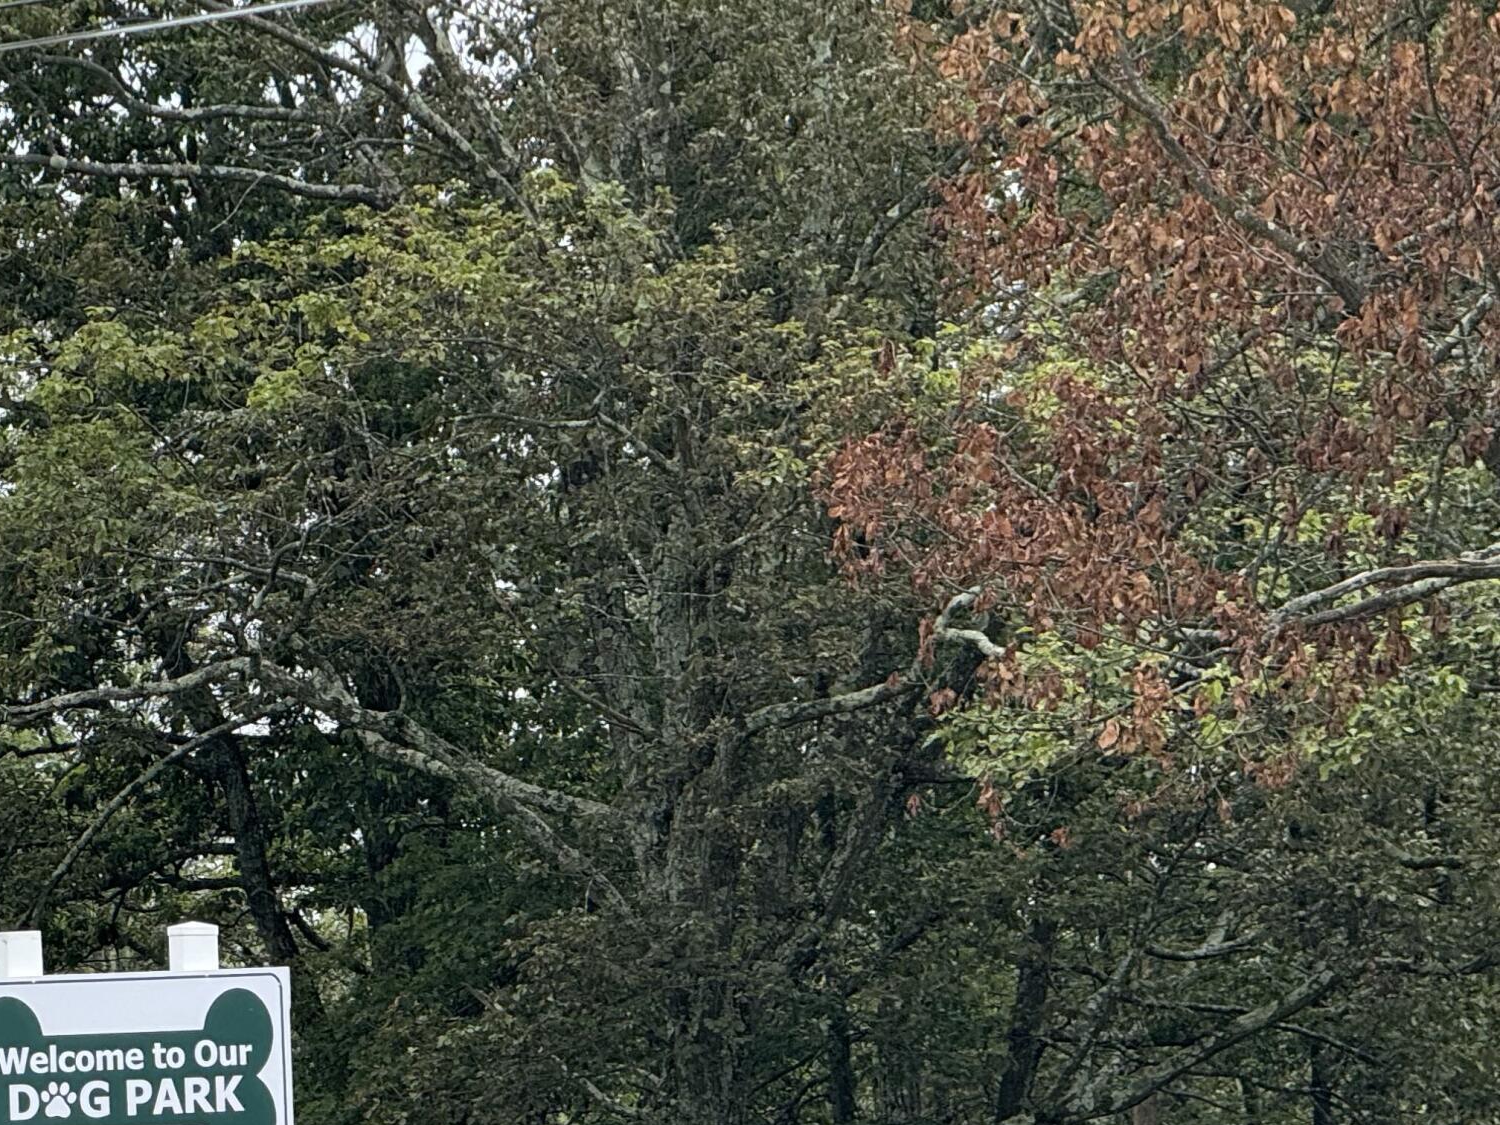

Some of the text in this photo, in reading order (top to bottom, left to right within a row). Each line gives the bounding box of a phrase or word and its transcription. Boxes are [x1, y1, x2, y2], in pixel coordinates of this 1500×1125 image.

[152, 1043, 185, 1068] to
[195, 1040, 252, 1067] Our
[126, 1075, 244, 1116] PARK
